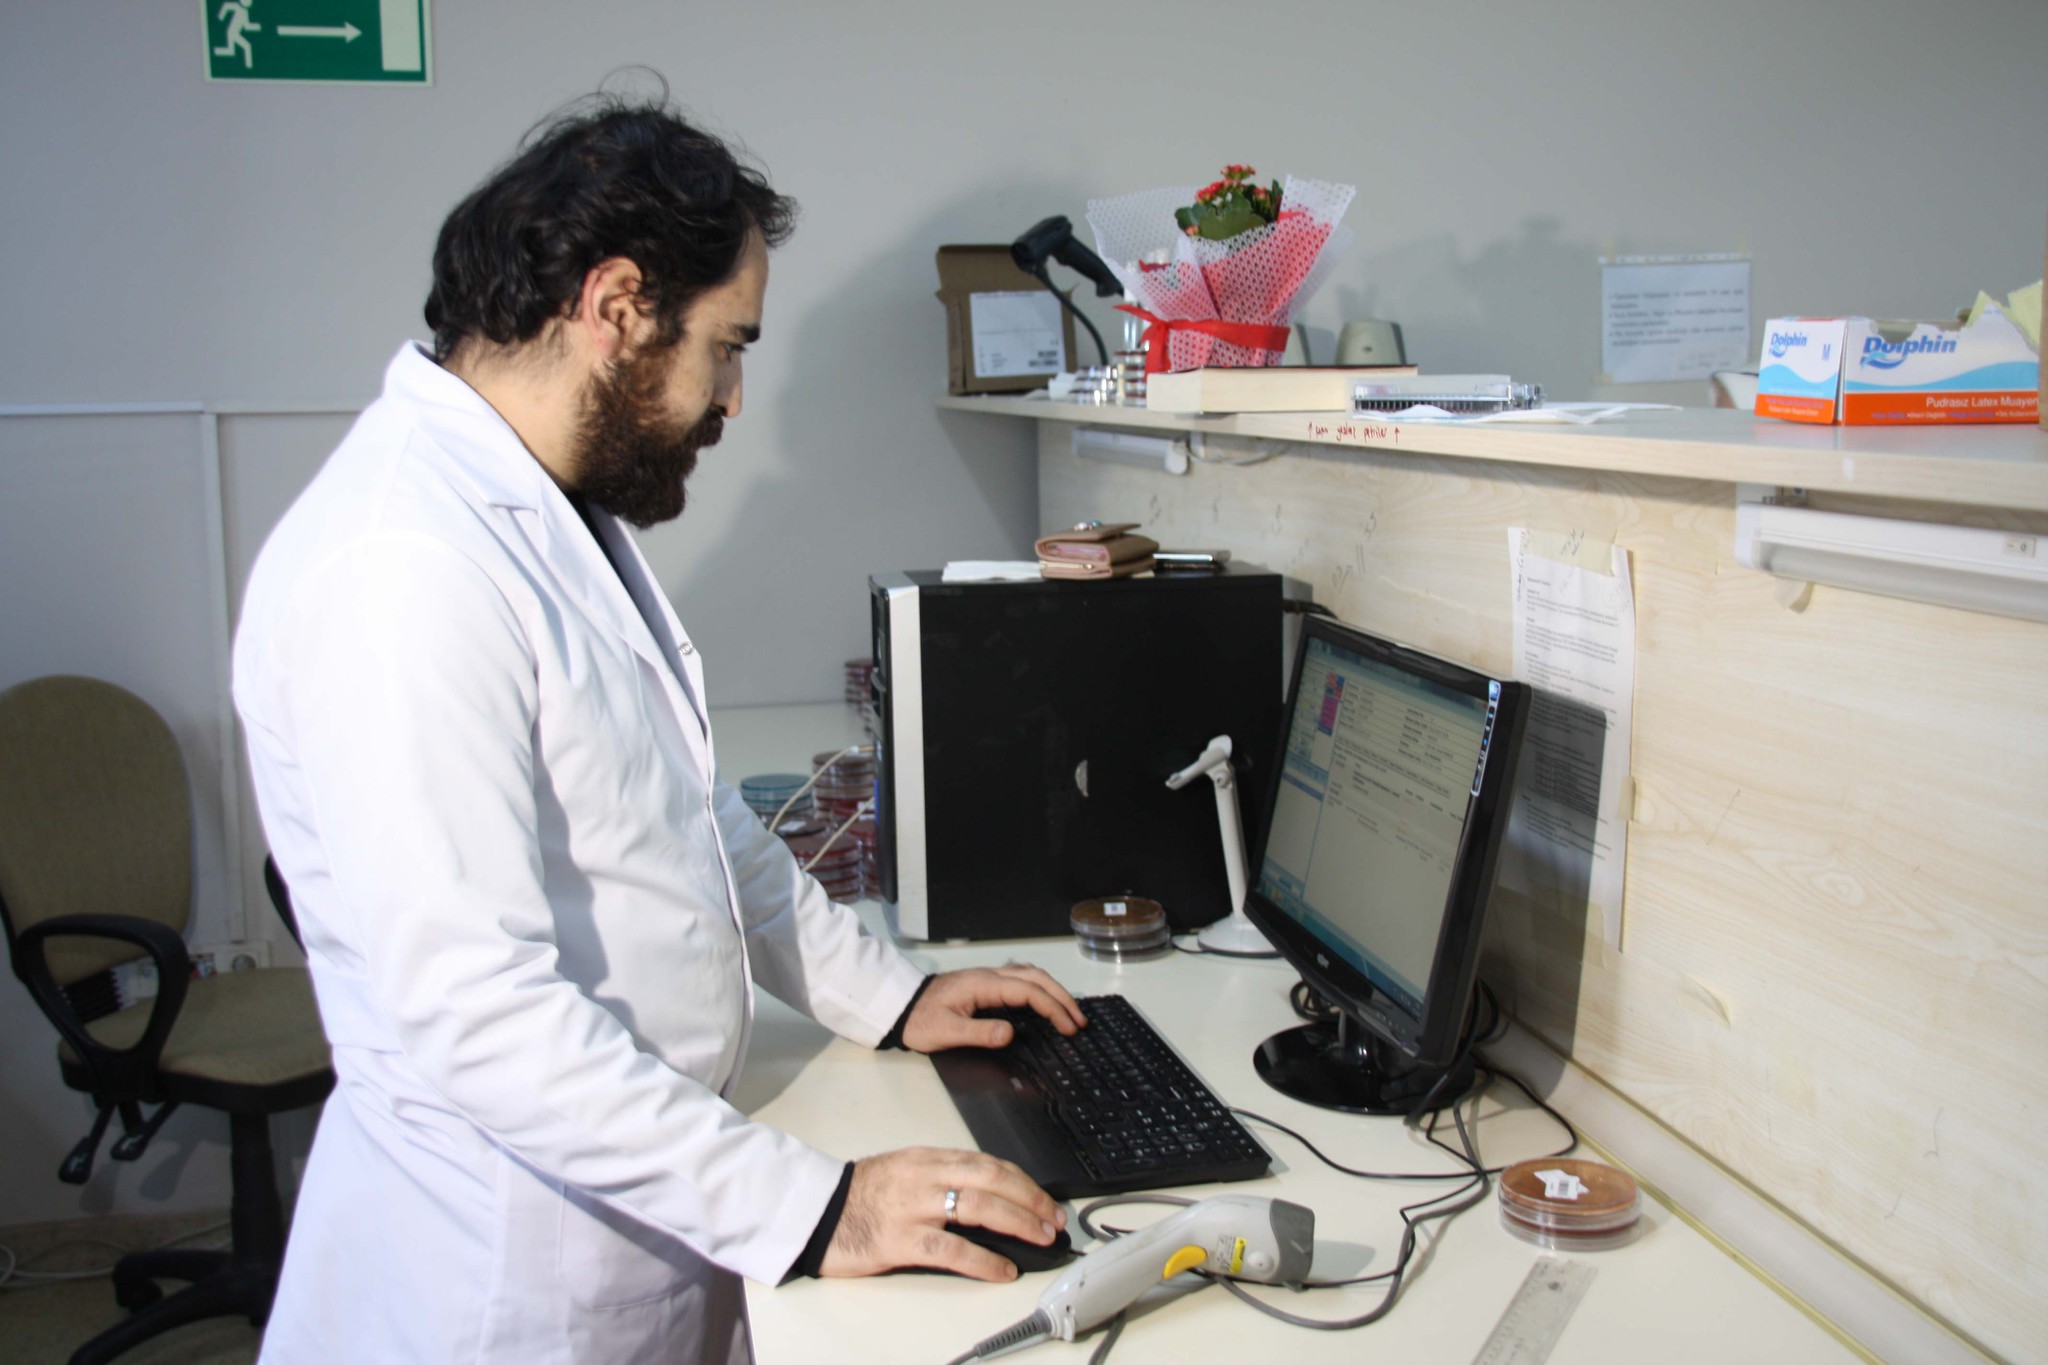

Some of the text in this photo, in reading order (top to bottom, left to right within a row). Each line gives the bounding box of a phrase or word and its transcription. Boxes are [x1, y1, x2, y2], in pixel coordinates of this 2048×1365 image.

[1771, 332, 1807, 349] Dolphin
[1822, 343, 1831, 361] M
[1972, 396, 1998, 407] Latex
